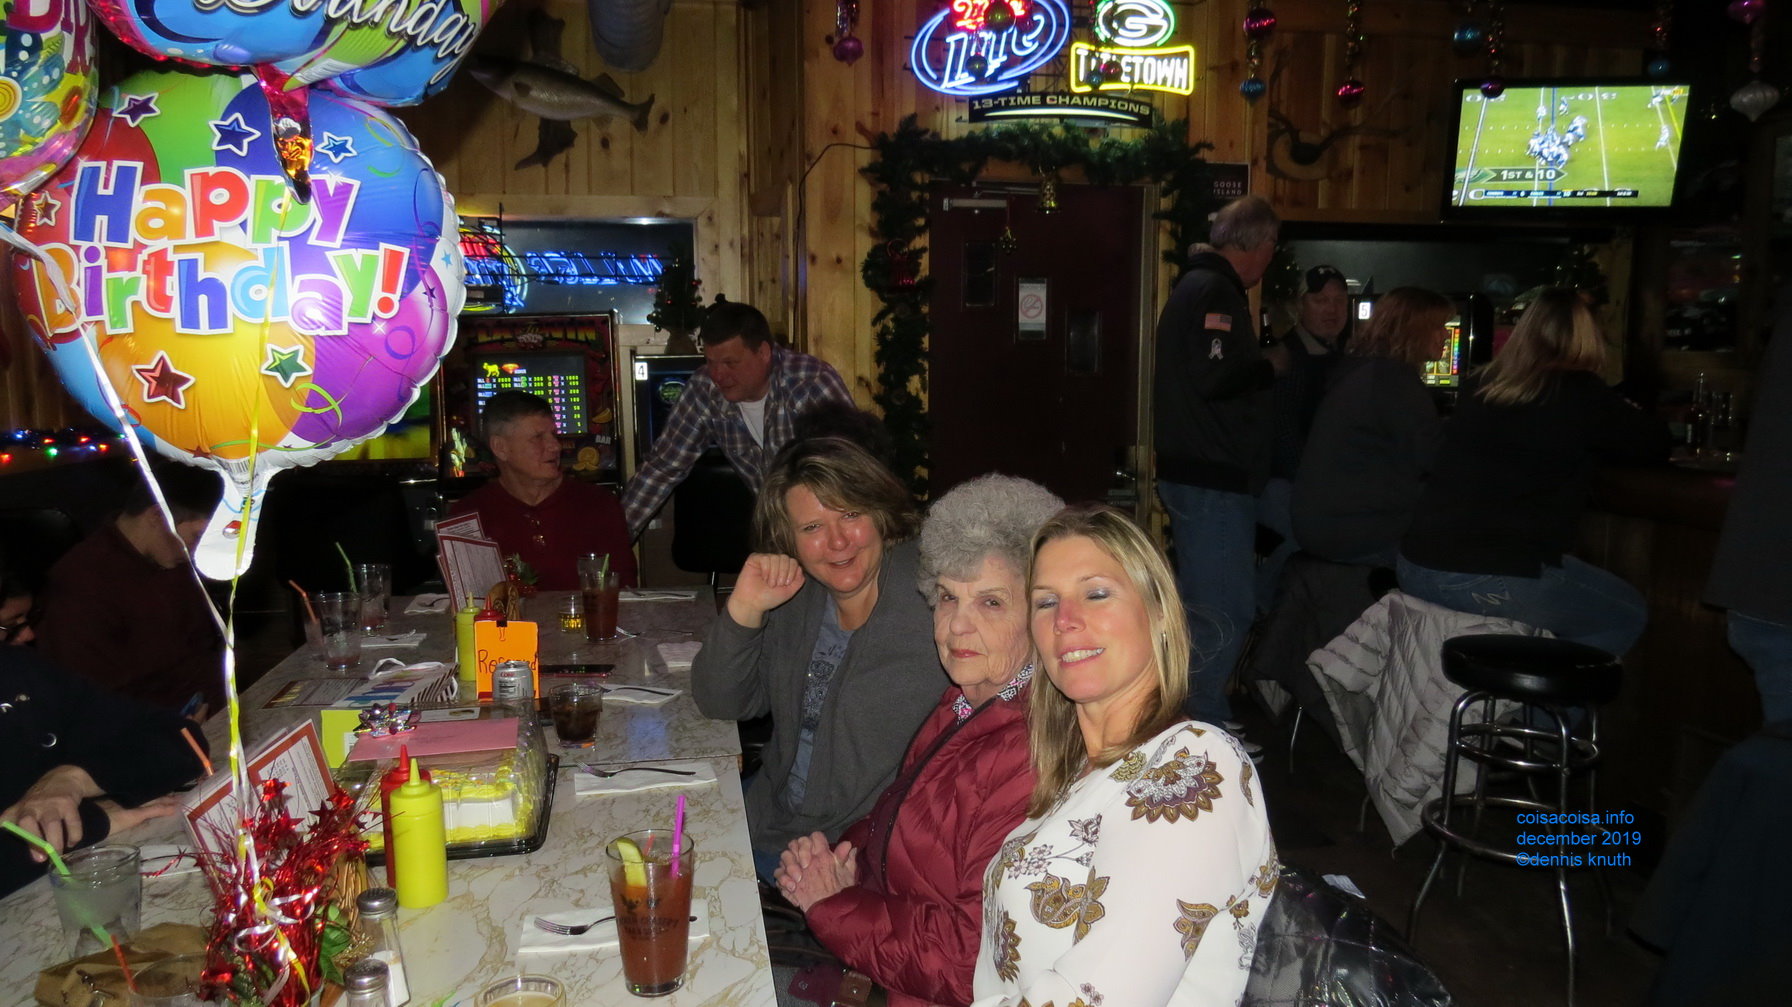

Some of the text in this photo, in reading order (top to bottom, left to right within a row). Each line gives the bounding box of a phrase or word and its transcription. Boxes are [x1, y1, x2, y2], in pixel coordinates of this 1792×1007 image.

[1076, 48, 1188, 90] TTETOWN
[973, 95, 1150, 116] 13-TIME CHAMPIONS
[1537, 169, 1556, 180] 10
[71, 160, 361, 248] Happy
[31, 241, 410, 336] Birthday!
